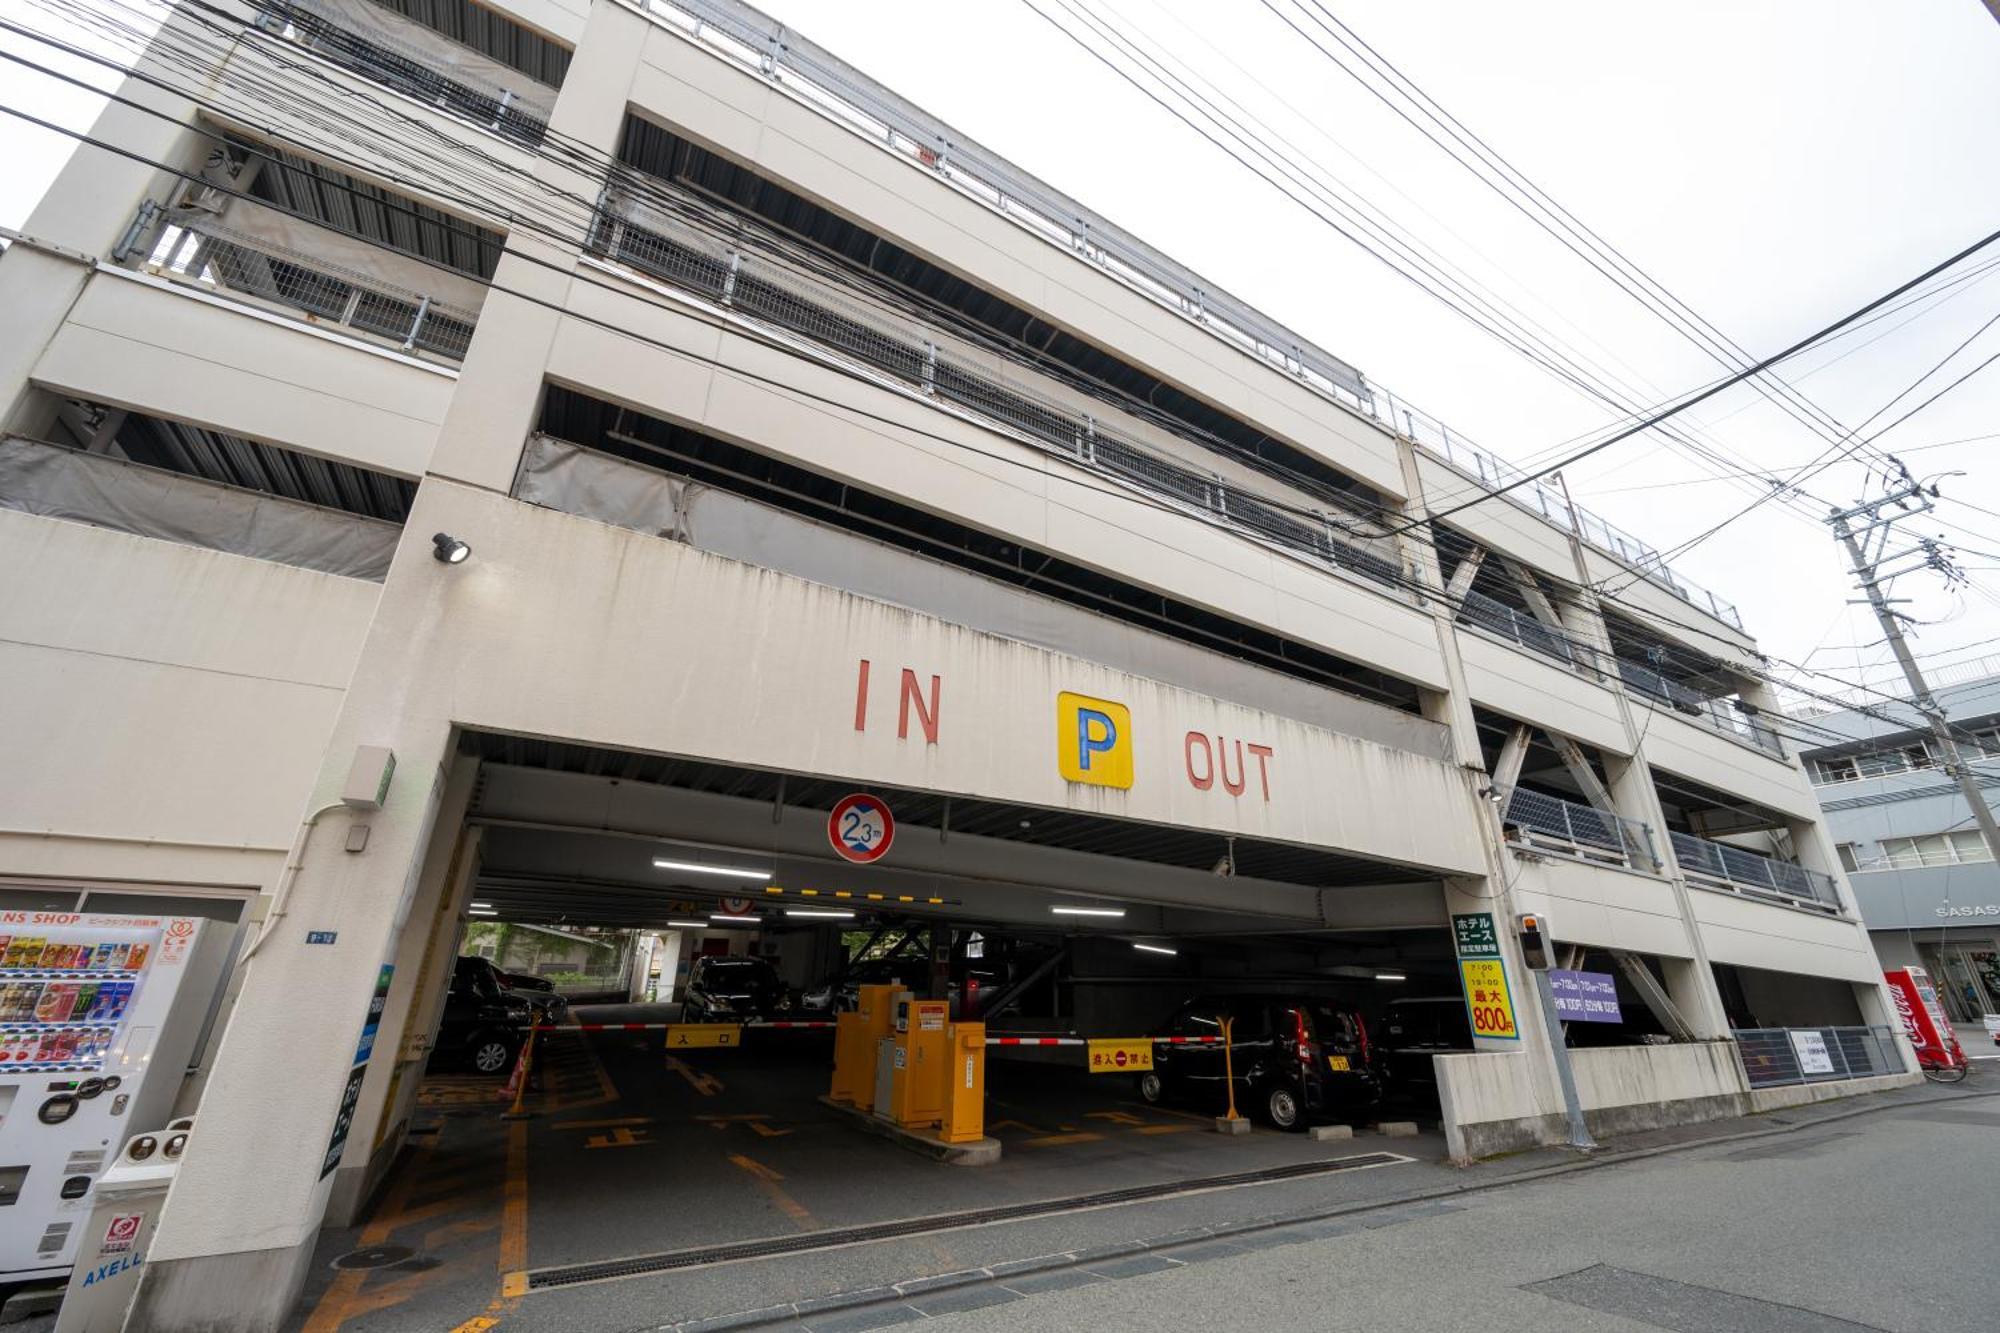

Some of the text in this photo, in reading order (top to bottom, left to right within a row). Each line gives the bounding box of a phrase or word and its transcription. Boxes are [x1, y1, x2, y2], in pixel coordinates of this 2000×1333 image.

[855, 659, 941, 745] IN
[1078, 707, 1117, 770] P
[1185, 731, 1273, 802] OUT
[1, 912, 80, 924] NS SHOP
[1935, 905, 2000, 918] SASAS
[1457, 918, 1490, 929] ホテル
[1460, 931, 1493, 942] エース
[1475, 990, 1502, 1003] 最大
[83, 1252, 141, 1288] AXELL
